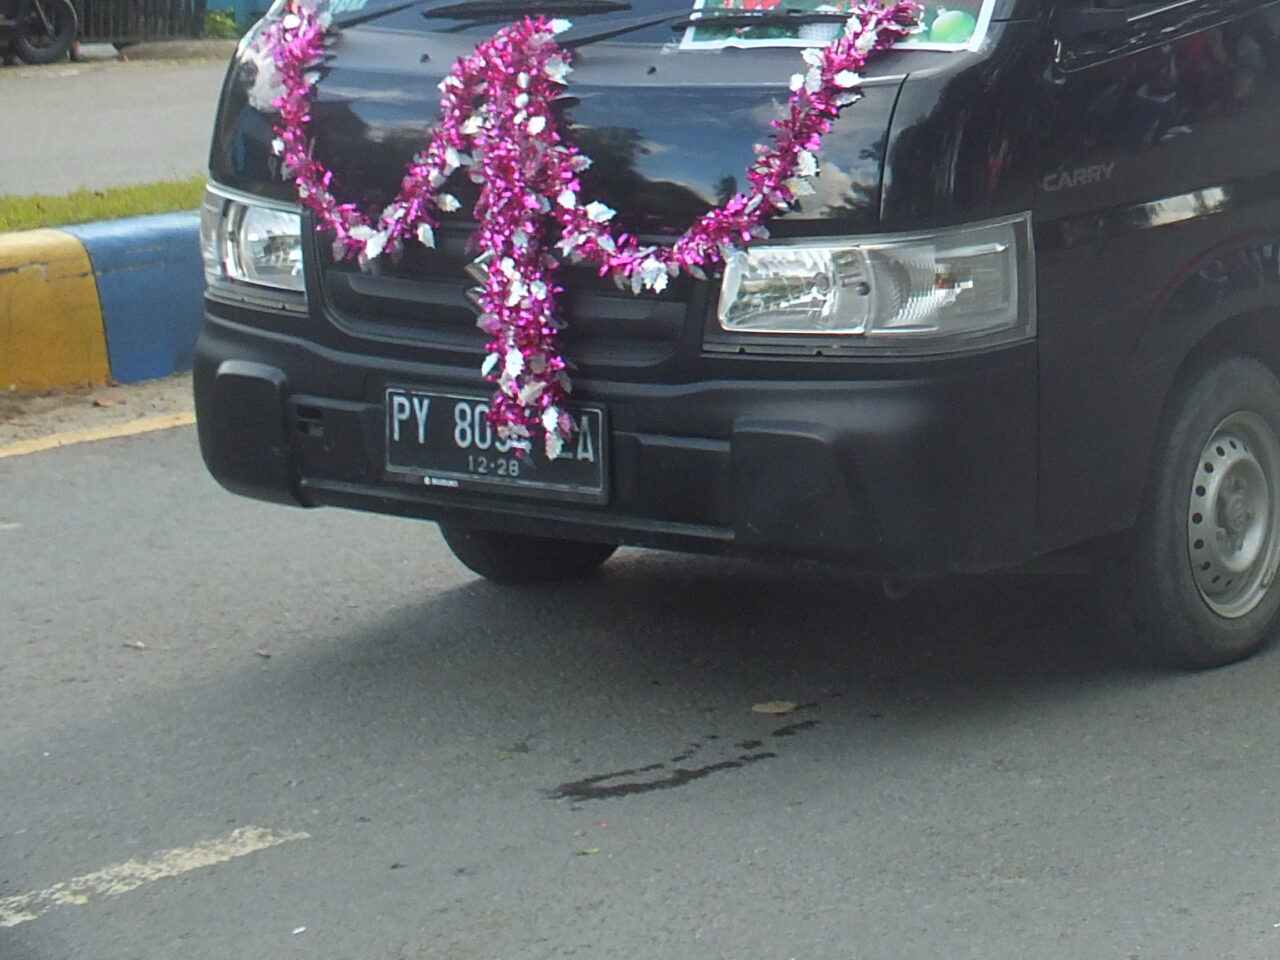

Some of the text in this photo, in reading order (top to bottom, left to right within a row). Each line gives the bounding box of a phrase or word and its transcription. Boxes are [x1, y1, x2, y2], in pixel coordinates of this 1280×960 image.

[1042, 160, 1116, 193] CARRY
[392, 395, 430, 445] PY
[453, 401, 532, 454] 80
